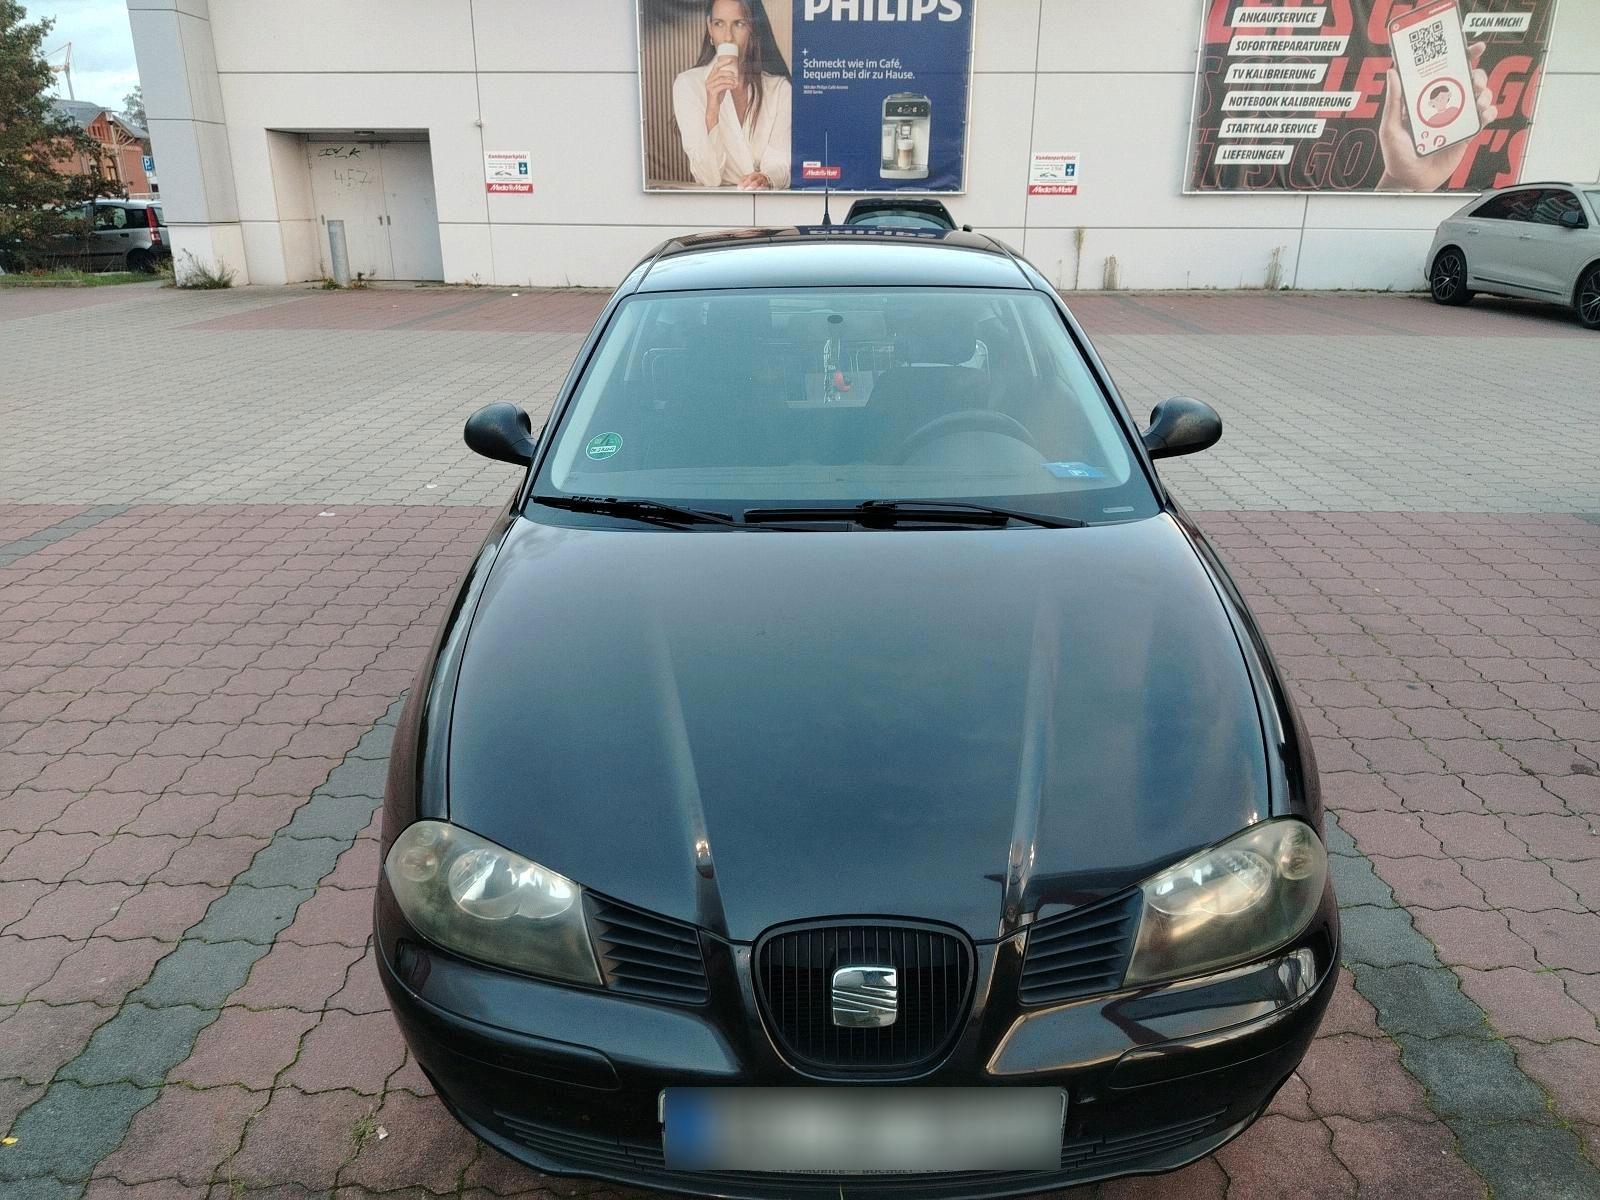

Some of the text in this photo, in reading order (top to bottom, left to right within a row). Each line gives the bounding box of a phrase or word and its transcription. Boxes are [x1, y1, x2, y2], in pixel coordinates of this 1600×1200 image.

[804, 0, 962, 22] PHILIPS
[1239, 12, 1318, 23] ANKAUFSERVICE
[1470, 17, 1523, 27] SCAN MICH!
[1236, 41, 1341, 51] SOFORTREPARATUREN
[803, 58, 902, 70] Schmeckt wie im Café,
[803, 69, 916, 80] bequem bei dir zu Hause.
[1232, 69, 1316, 80] TV KALIBRIERUNG
[1228, 97, 1352, 107] NOTEBOOK KALIBRIERUNG
[1225, 123, 1319, 134] STARTKLAR SERVICE
[1222, 150, 1285, 160] LIEFERUNGEN
